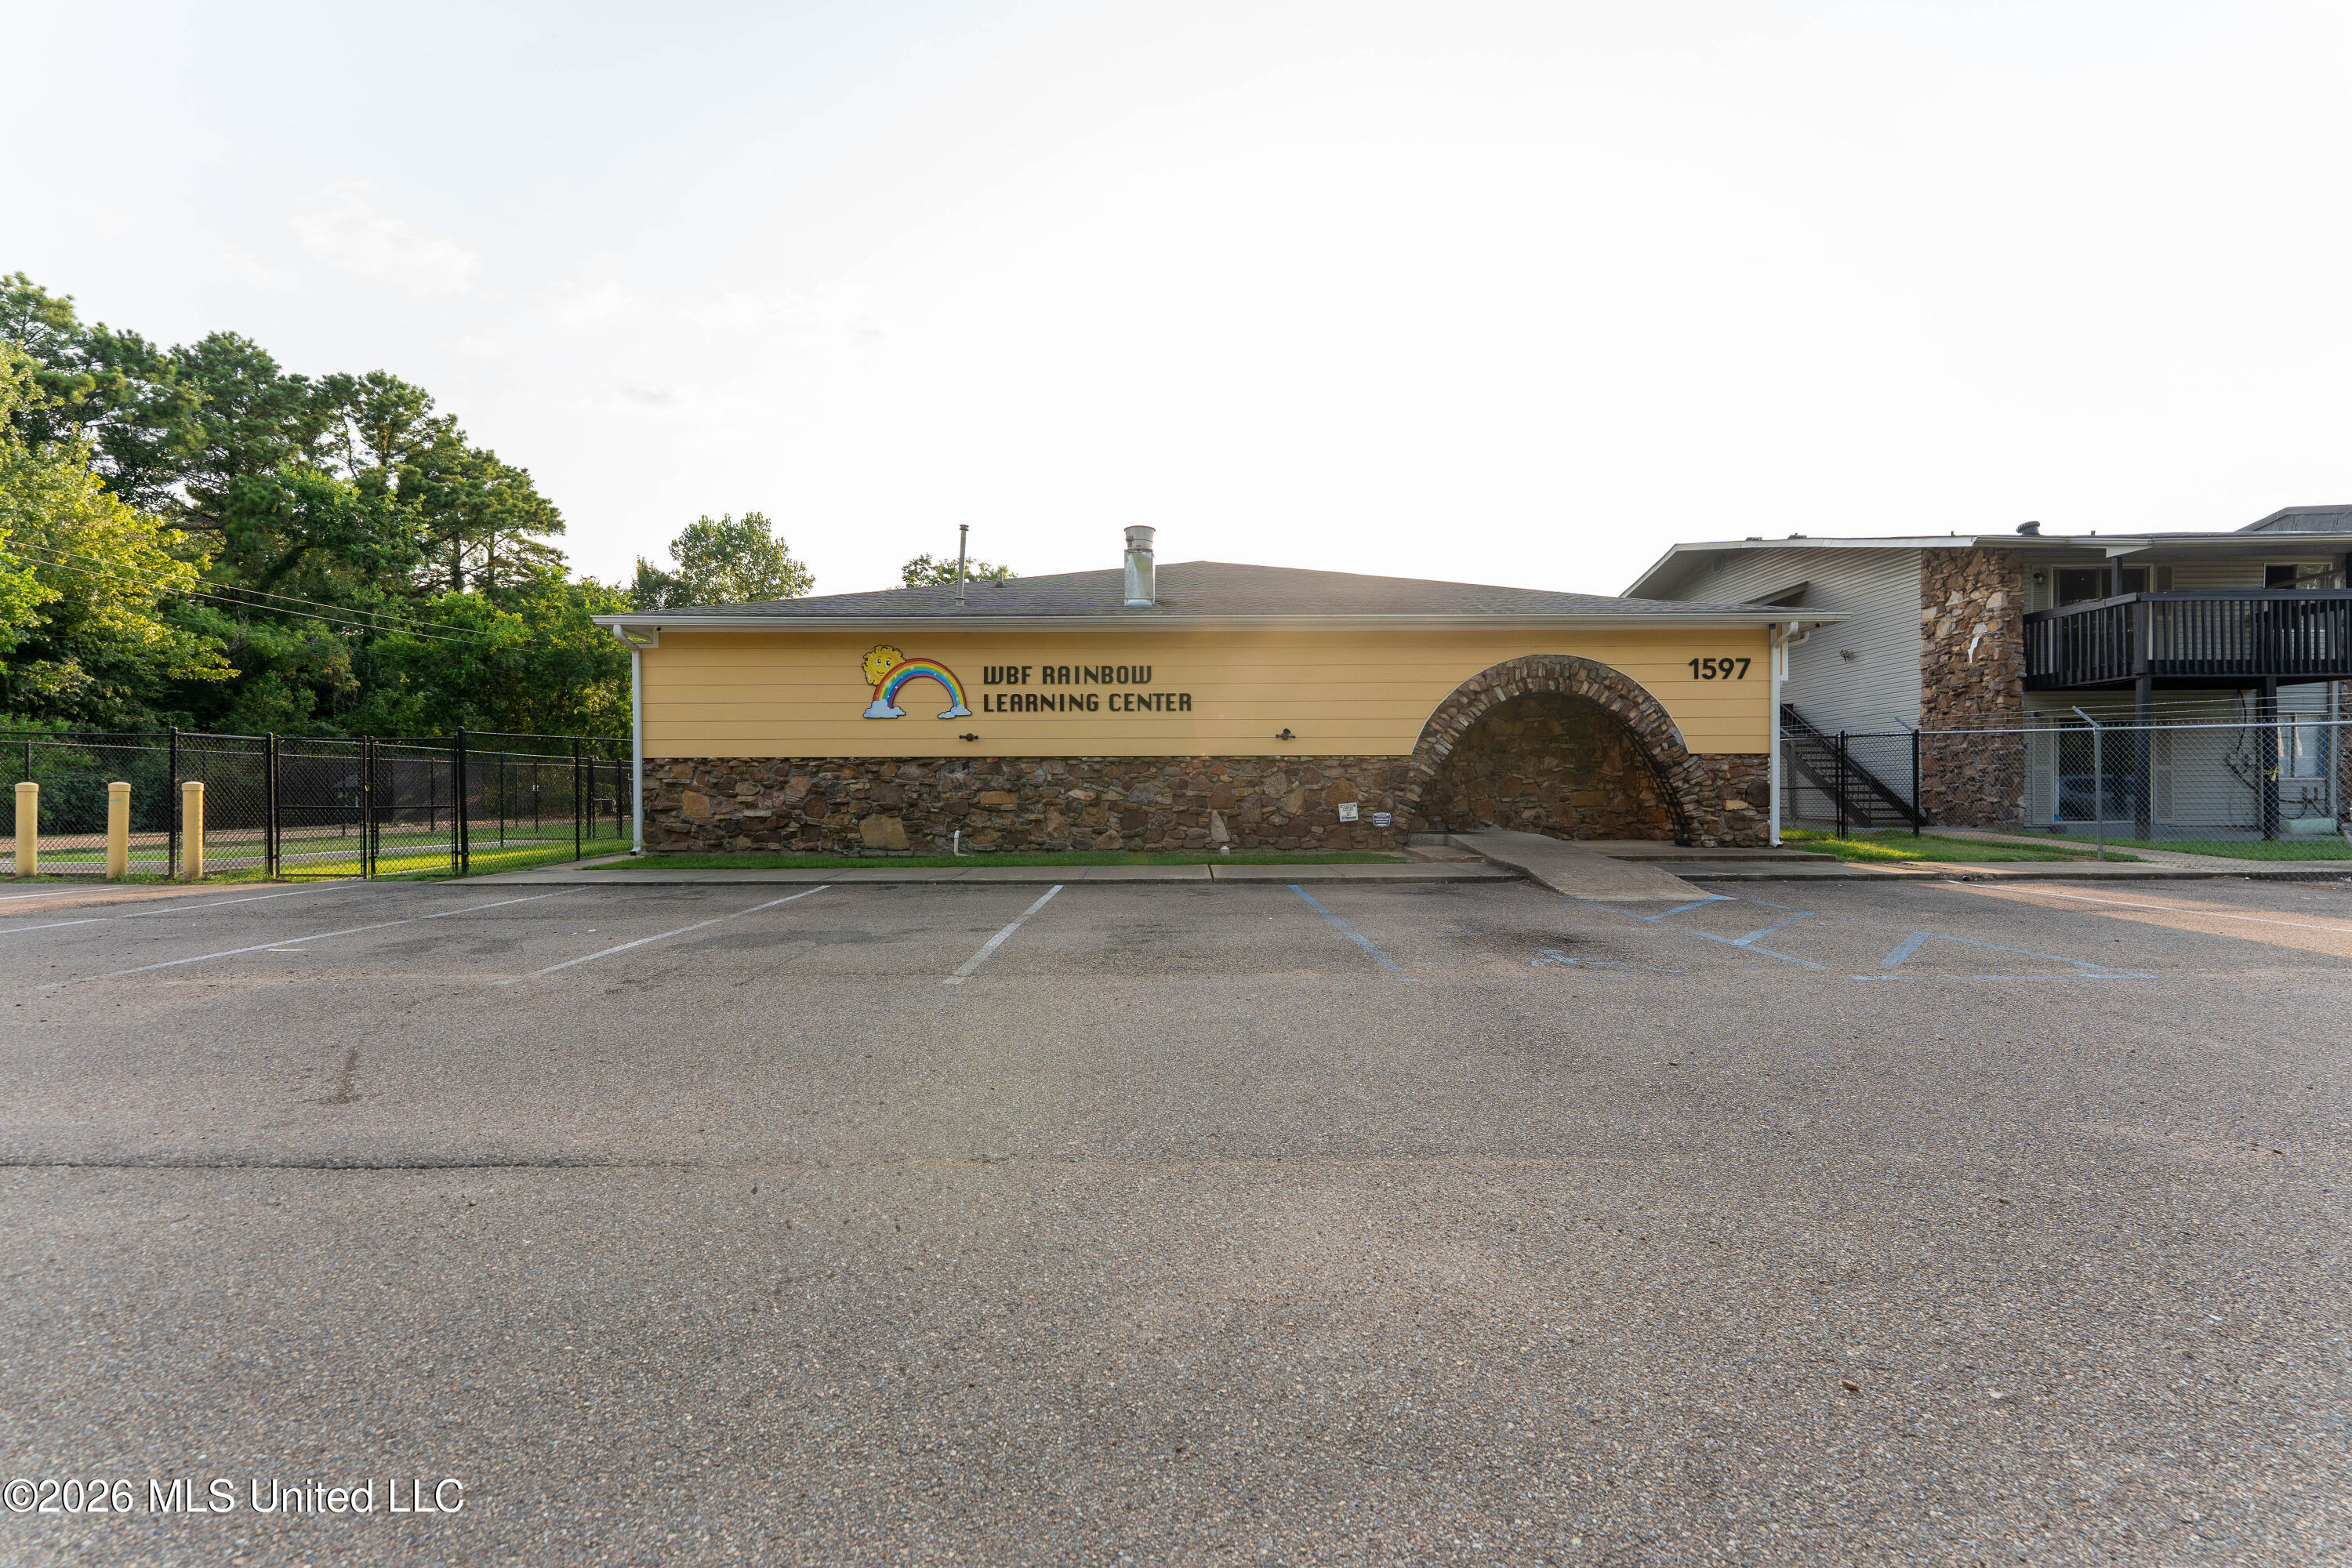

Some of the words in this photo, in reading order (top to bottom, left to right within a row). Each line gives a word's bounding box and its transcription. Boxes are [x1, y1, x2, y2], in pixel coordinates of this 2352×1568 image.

[983, 666, 1032, 684] WBF
[1043, 665, 1152, 684] RAINBOW
[1688, 658, 1751, 680] 1597
[983, 693, 1099, 713] LEARNING
[1109, 693, 1192, 712] CENTER
